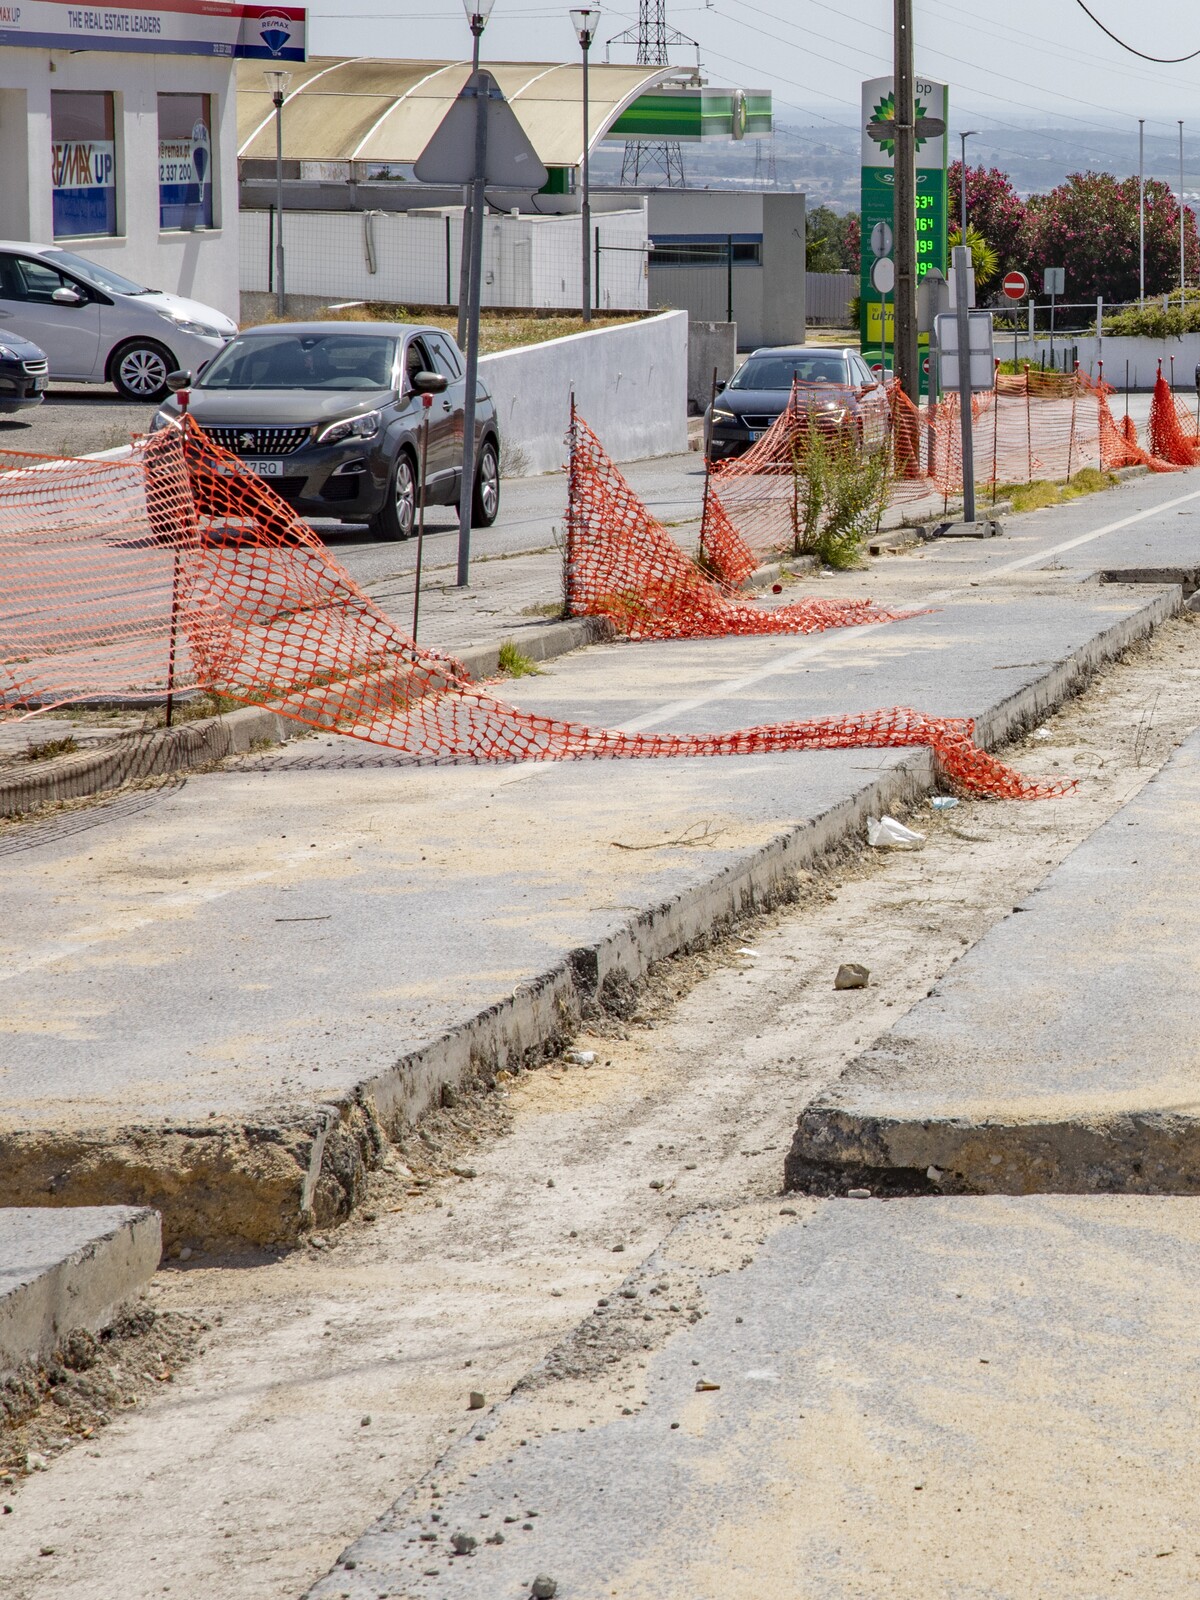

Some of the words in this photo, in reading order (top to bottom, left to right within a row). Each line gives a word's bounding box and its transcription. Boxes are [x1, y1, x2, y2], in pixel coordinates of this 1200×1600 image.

[68, 10, 82, 28] THE
[84, 11, 103, 30] REAL
[104, 13, 130, 32] ESTATE
[130, 15, 161, 34] LEADERS
[261, 20, 289, 29] RE/MAX
[915, 81, 932, 96] bp
[95, 154, 112, 184] UP
[166, 164, 178, 181] 337
[179, 163, 192, 181] 200
